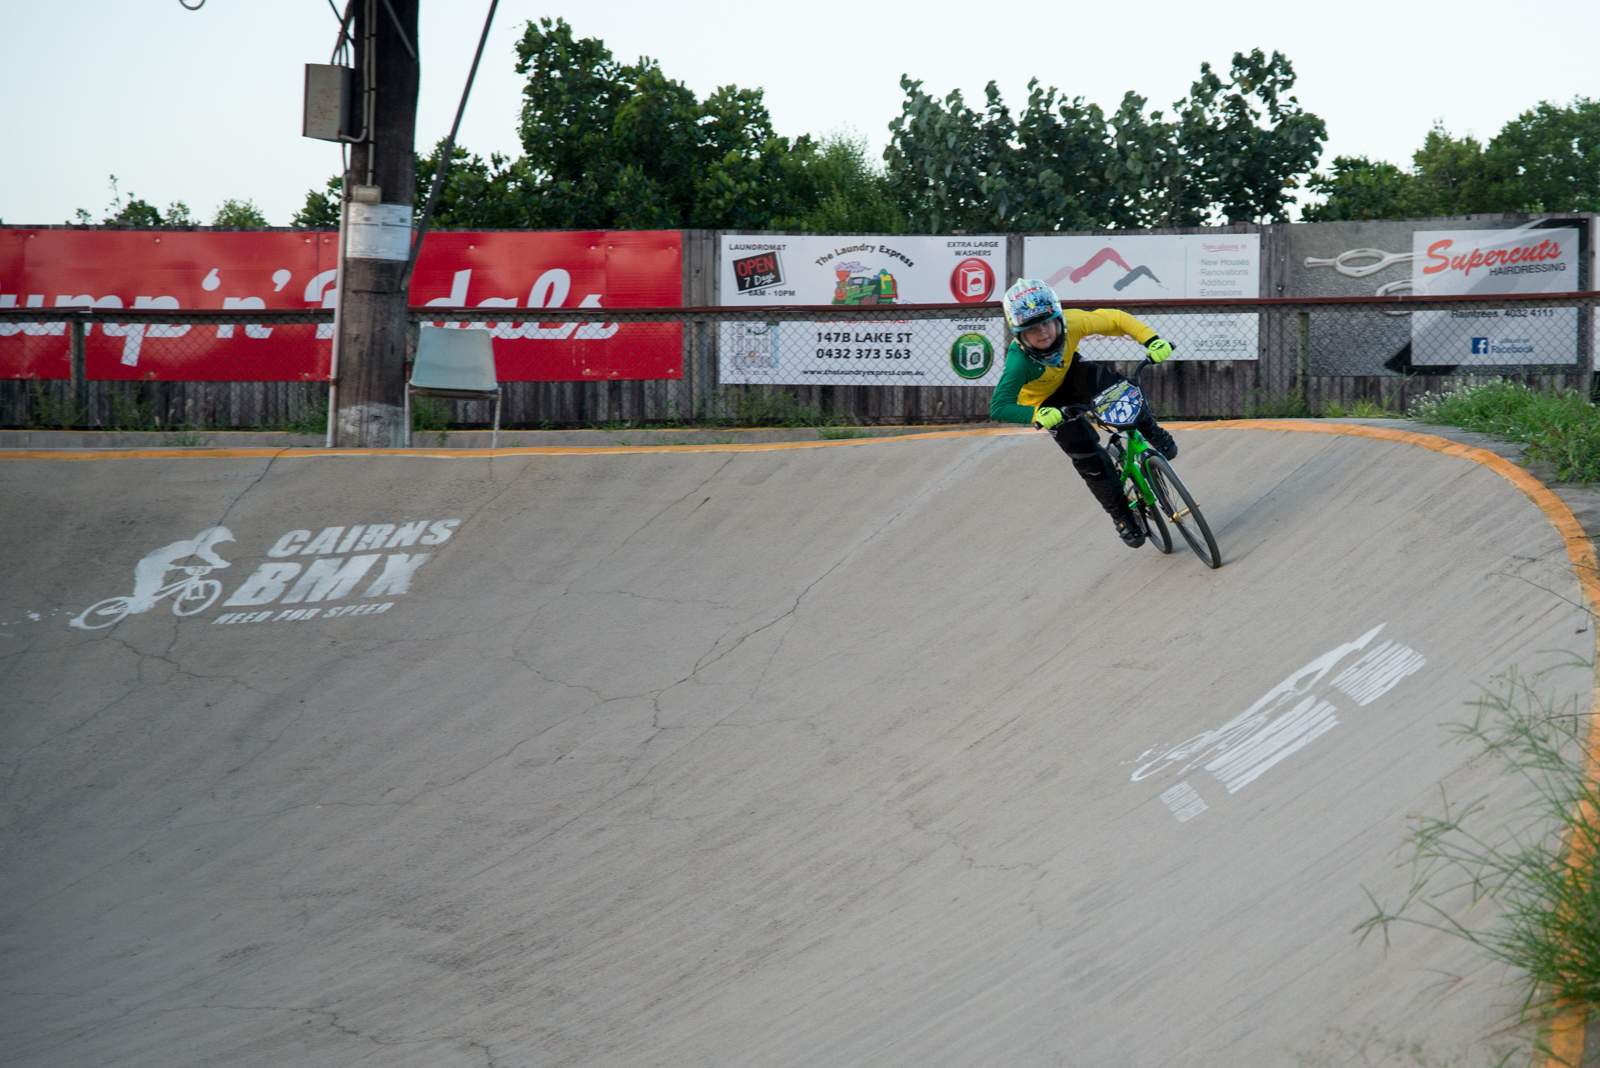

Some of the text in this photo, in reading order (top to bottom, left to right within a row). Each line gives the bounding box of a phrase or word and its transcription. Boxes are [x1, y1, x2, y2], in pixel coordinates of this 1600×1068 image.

[728, 243, 787, 251] LAUNDROMAT
[815, 243, 915, 267] The Laundry Express
[1423, 239, 1562, 277] Supercuts
[736, 255, 776, 277] OPEN
[1489, 262, 1567, 276] HAIRDRESSING
[743, 276, 751, 288] 7
[817, 332, 913, 343] 147B LAKE ST
[816, 348, 911, 359] 0432 373 563
[267, 519, 462, 558] CAIRNS
[222, 551, 433, 607] BMX
[211, 602, 395, 625] NEED FOR SPEED
